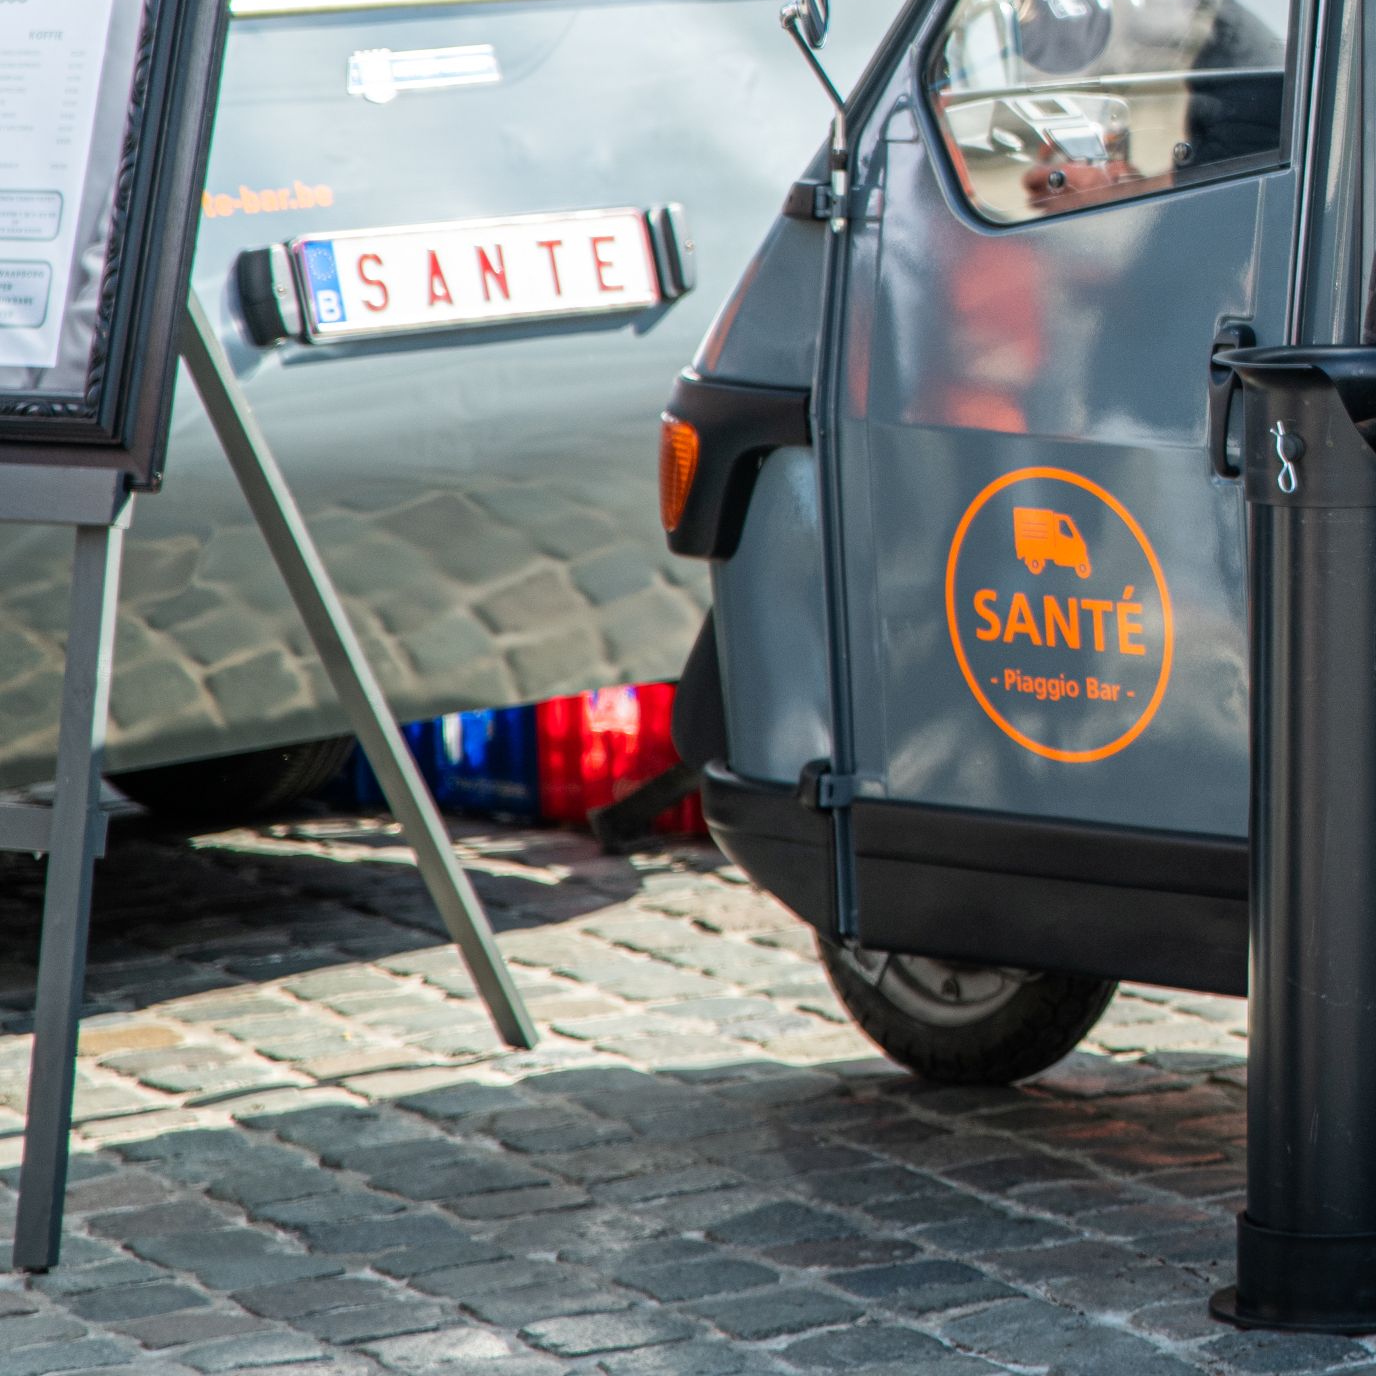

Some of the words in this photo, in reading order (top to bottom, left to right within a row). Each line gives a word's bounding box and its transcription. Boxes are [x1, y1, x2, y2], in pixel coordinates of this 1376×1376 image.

[316, 290, 343, 323] B
[357, 234, 625, 313] SANTE
[972, 585, 1147, 656] SANTÉ
[1004, 669, 1079, 702] Piaggio
[1086, 677, 1121, 701] Bar
